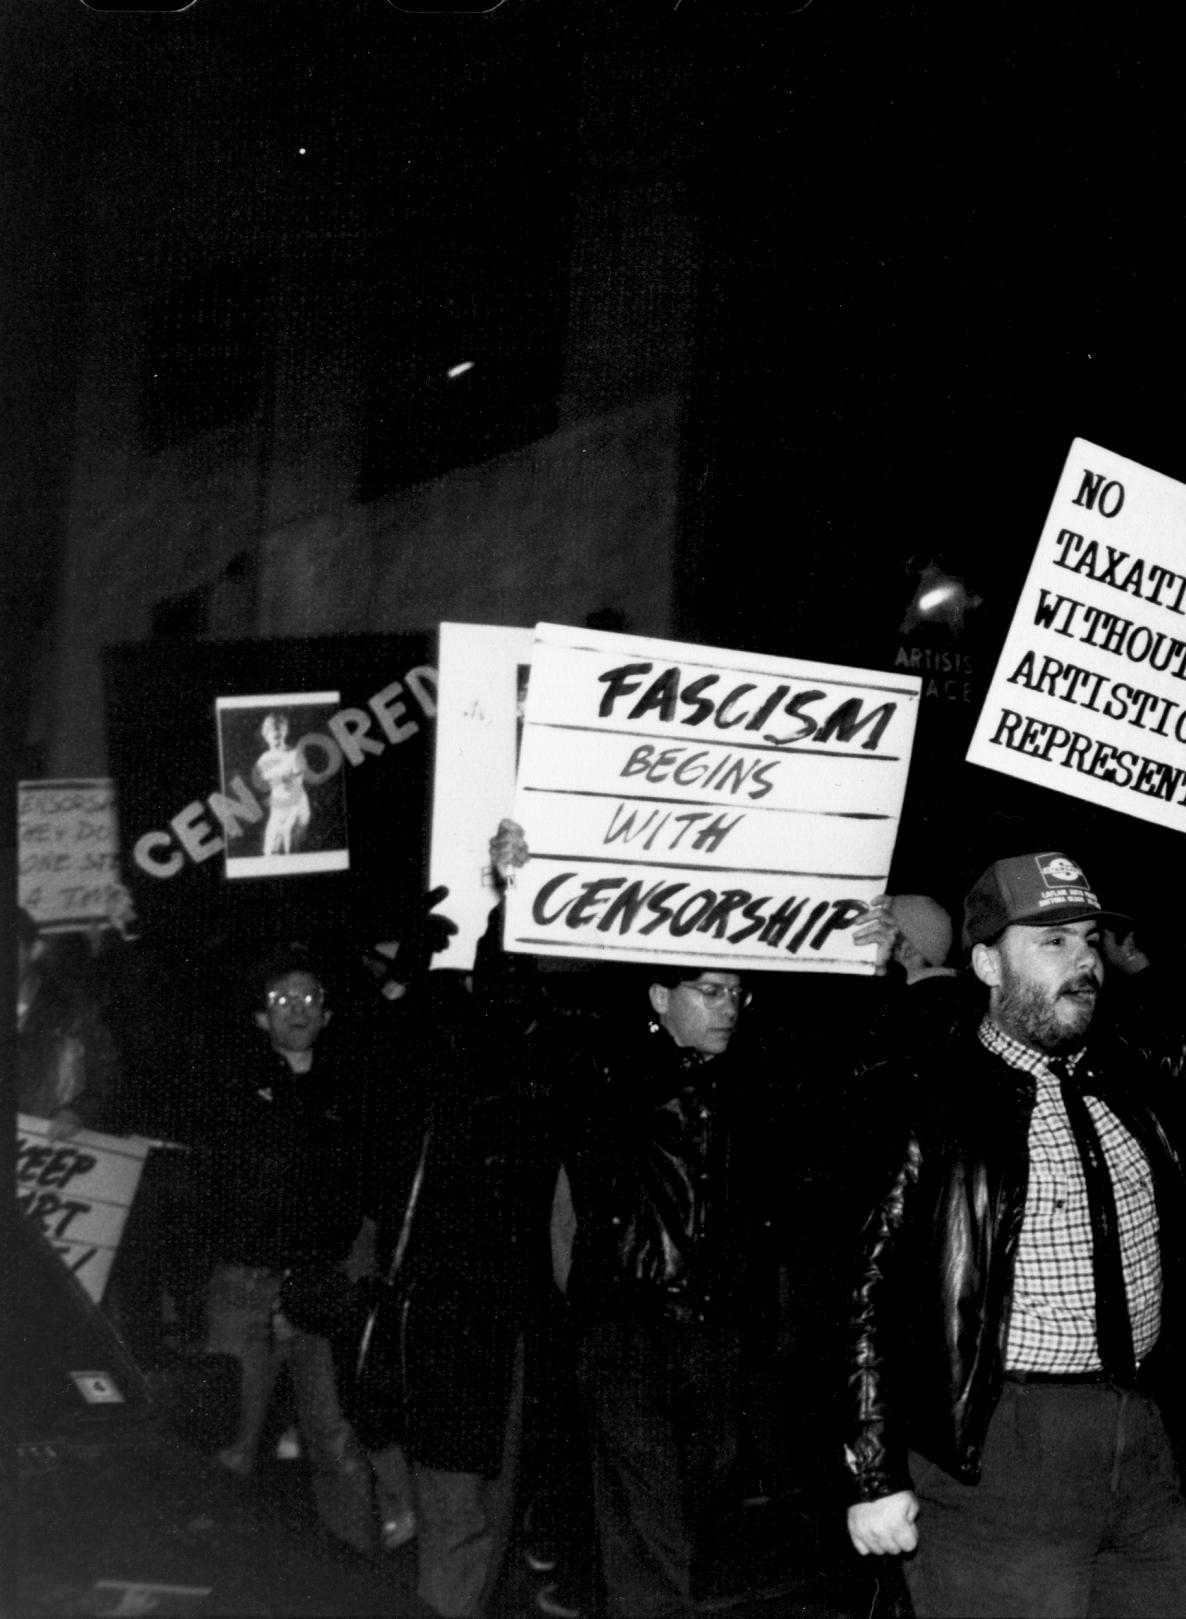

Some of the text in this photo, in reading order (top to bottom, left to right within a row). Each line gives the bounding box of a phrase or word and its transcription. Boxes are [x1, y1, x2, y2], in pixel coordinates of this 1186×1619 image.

[1072, 469, 1125, 518] NO
[894, 646, 973, 674] ARTISTS
[598, 661, 897, 750] FASCISM
[925, 679, 971, 703] ACE
[133, 665, 437, 879] CENORED
[620, 744, 782, 799] BEGINS
[603, 802, 745, 853] WITH
[531, 872, 868, 954] CENSORSHIP
